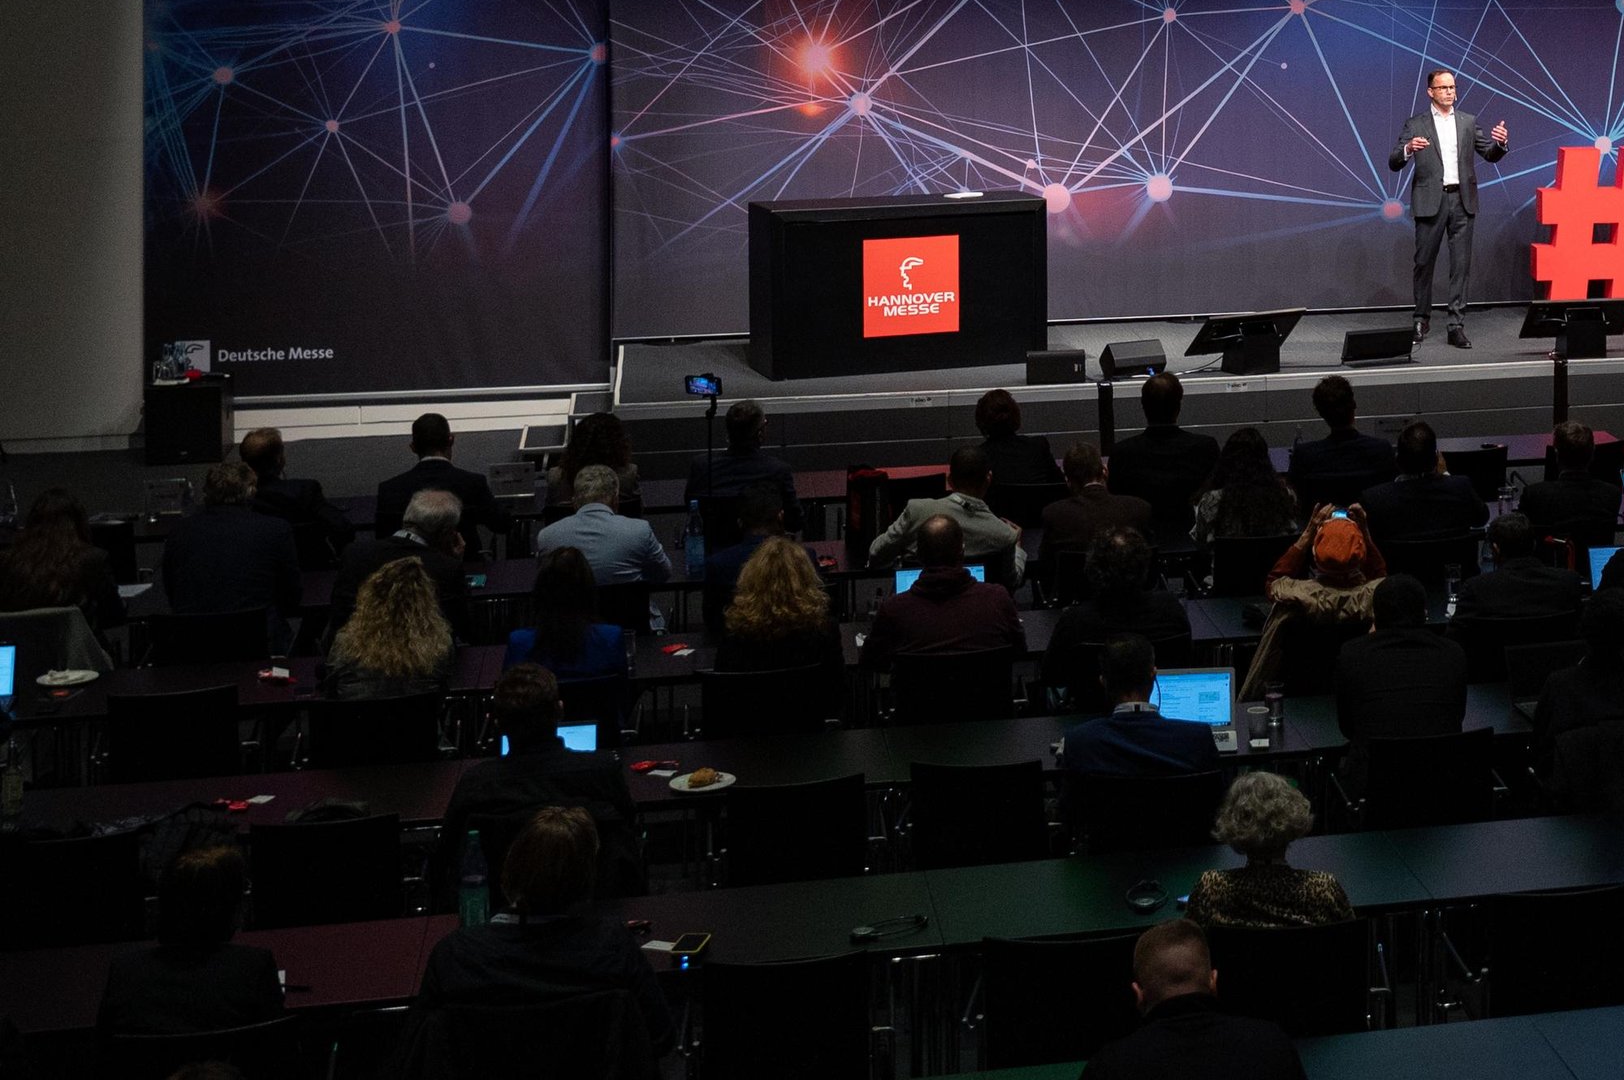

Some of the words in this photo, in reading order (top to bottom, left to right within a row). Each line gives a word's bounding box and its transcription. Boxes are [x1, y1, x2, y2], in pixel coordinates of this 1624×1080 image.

[868, 291, 955, 307] HANNOVER
[883, 303, 940, 316] MESSE
[218, 347, 285, 362] Deutsche
[288, 346, 333, 360] Messe
